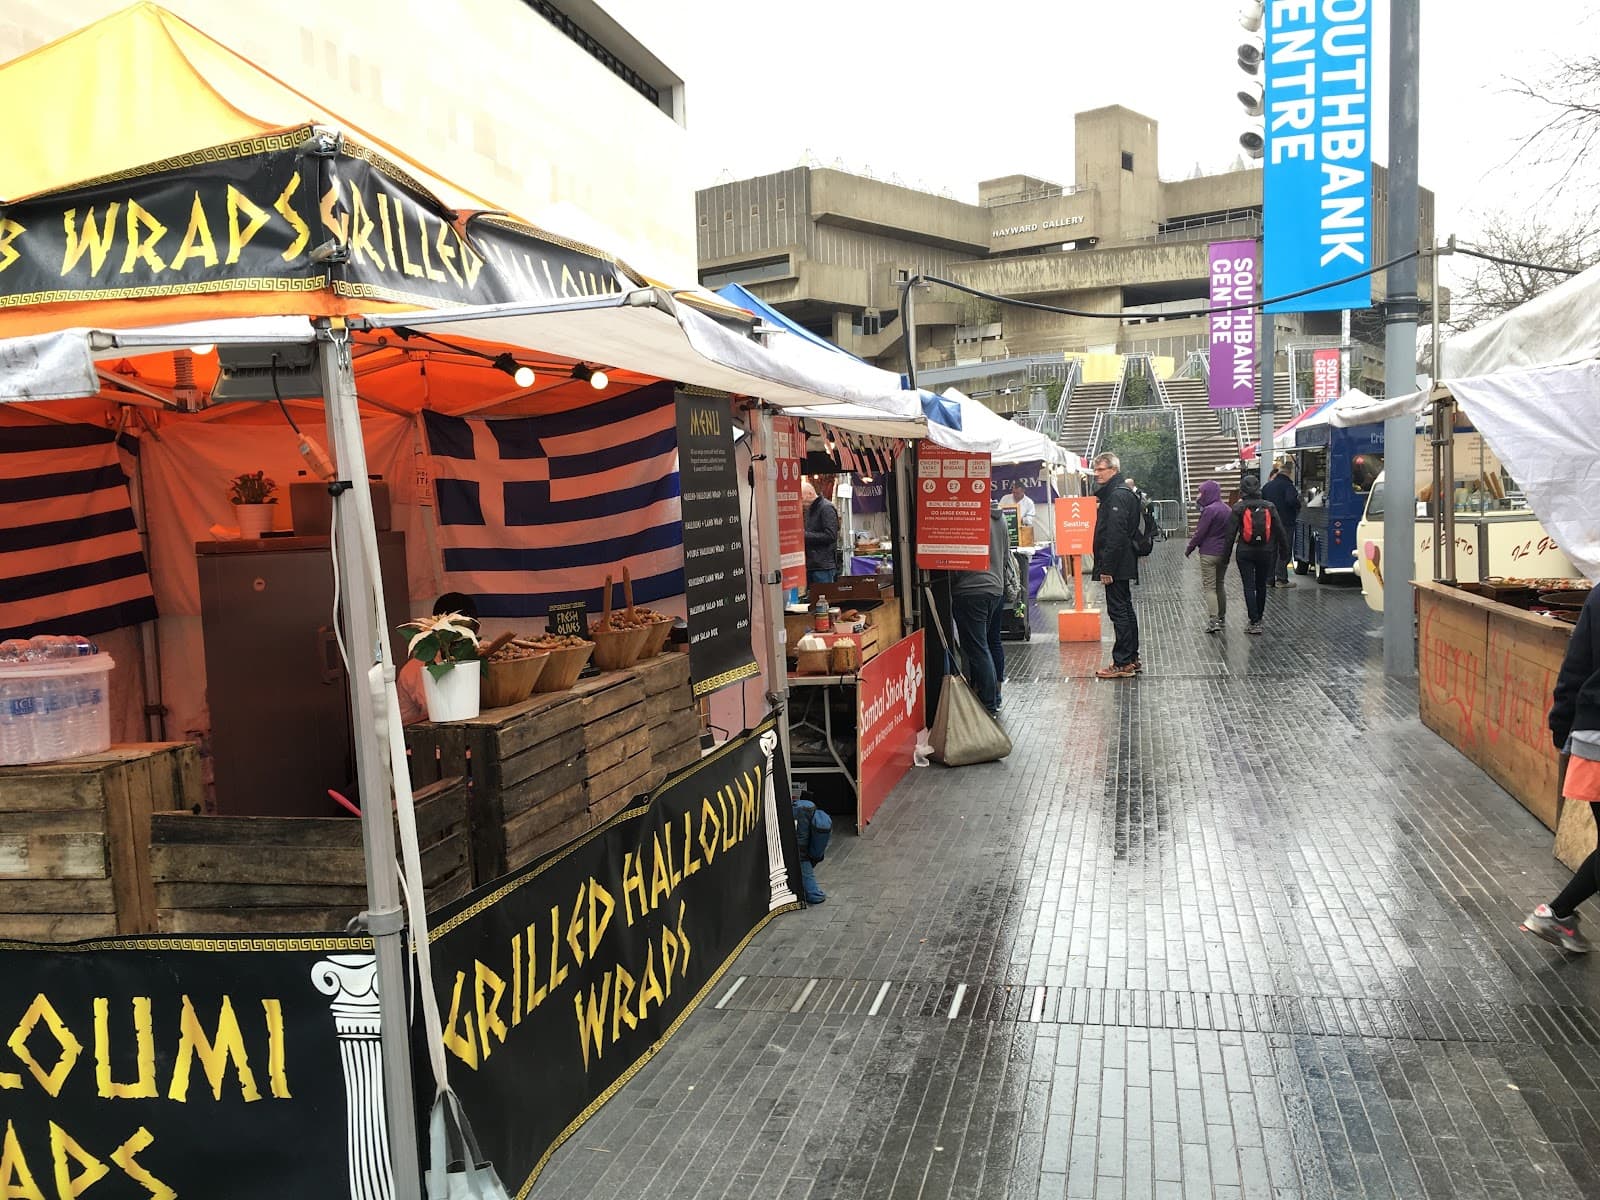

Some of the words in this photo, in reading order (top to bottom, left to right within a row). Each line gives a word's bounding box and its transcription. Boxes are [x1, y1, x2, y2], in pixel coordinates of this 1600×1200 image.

[1271, 0, 1316, 164] ENTRE
[1321, 0, 1366, 267] OUTHBANK
[60, 171, 311, 277] WRAPS
[320, 175, 485, 290] GRILLED
[992, 224, 1038, 238] HAYWARD
[1042, 215, 1084, 229] GALLERY
[1233, 257, 1253, 389] SOUTHBANK
[1327, 358, 1337, 398] SOUTH
[690, 408, 720, 436] MENU
[925, 482, 934, 490] £6
[949, 482, 958, 490] £7
[1063, 520, 1089, 528] Seating
[557, 610, 578, 624] FRESH
[557, 622, 580, 634] OLIVES
[860, 688, 885, 737] Sambal
[442, 876, 615, 1071] GRILLED
[623, 766, 760, 927] HALLOUMI
[574, 900, 691, 1072] WRAPS
[0, 992, 292, 1103] OUMI
[0, 1119, 178, 1200] APS
